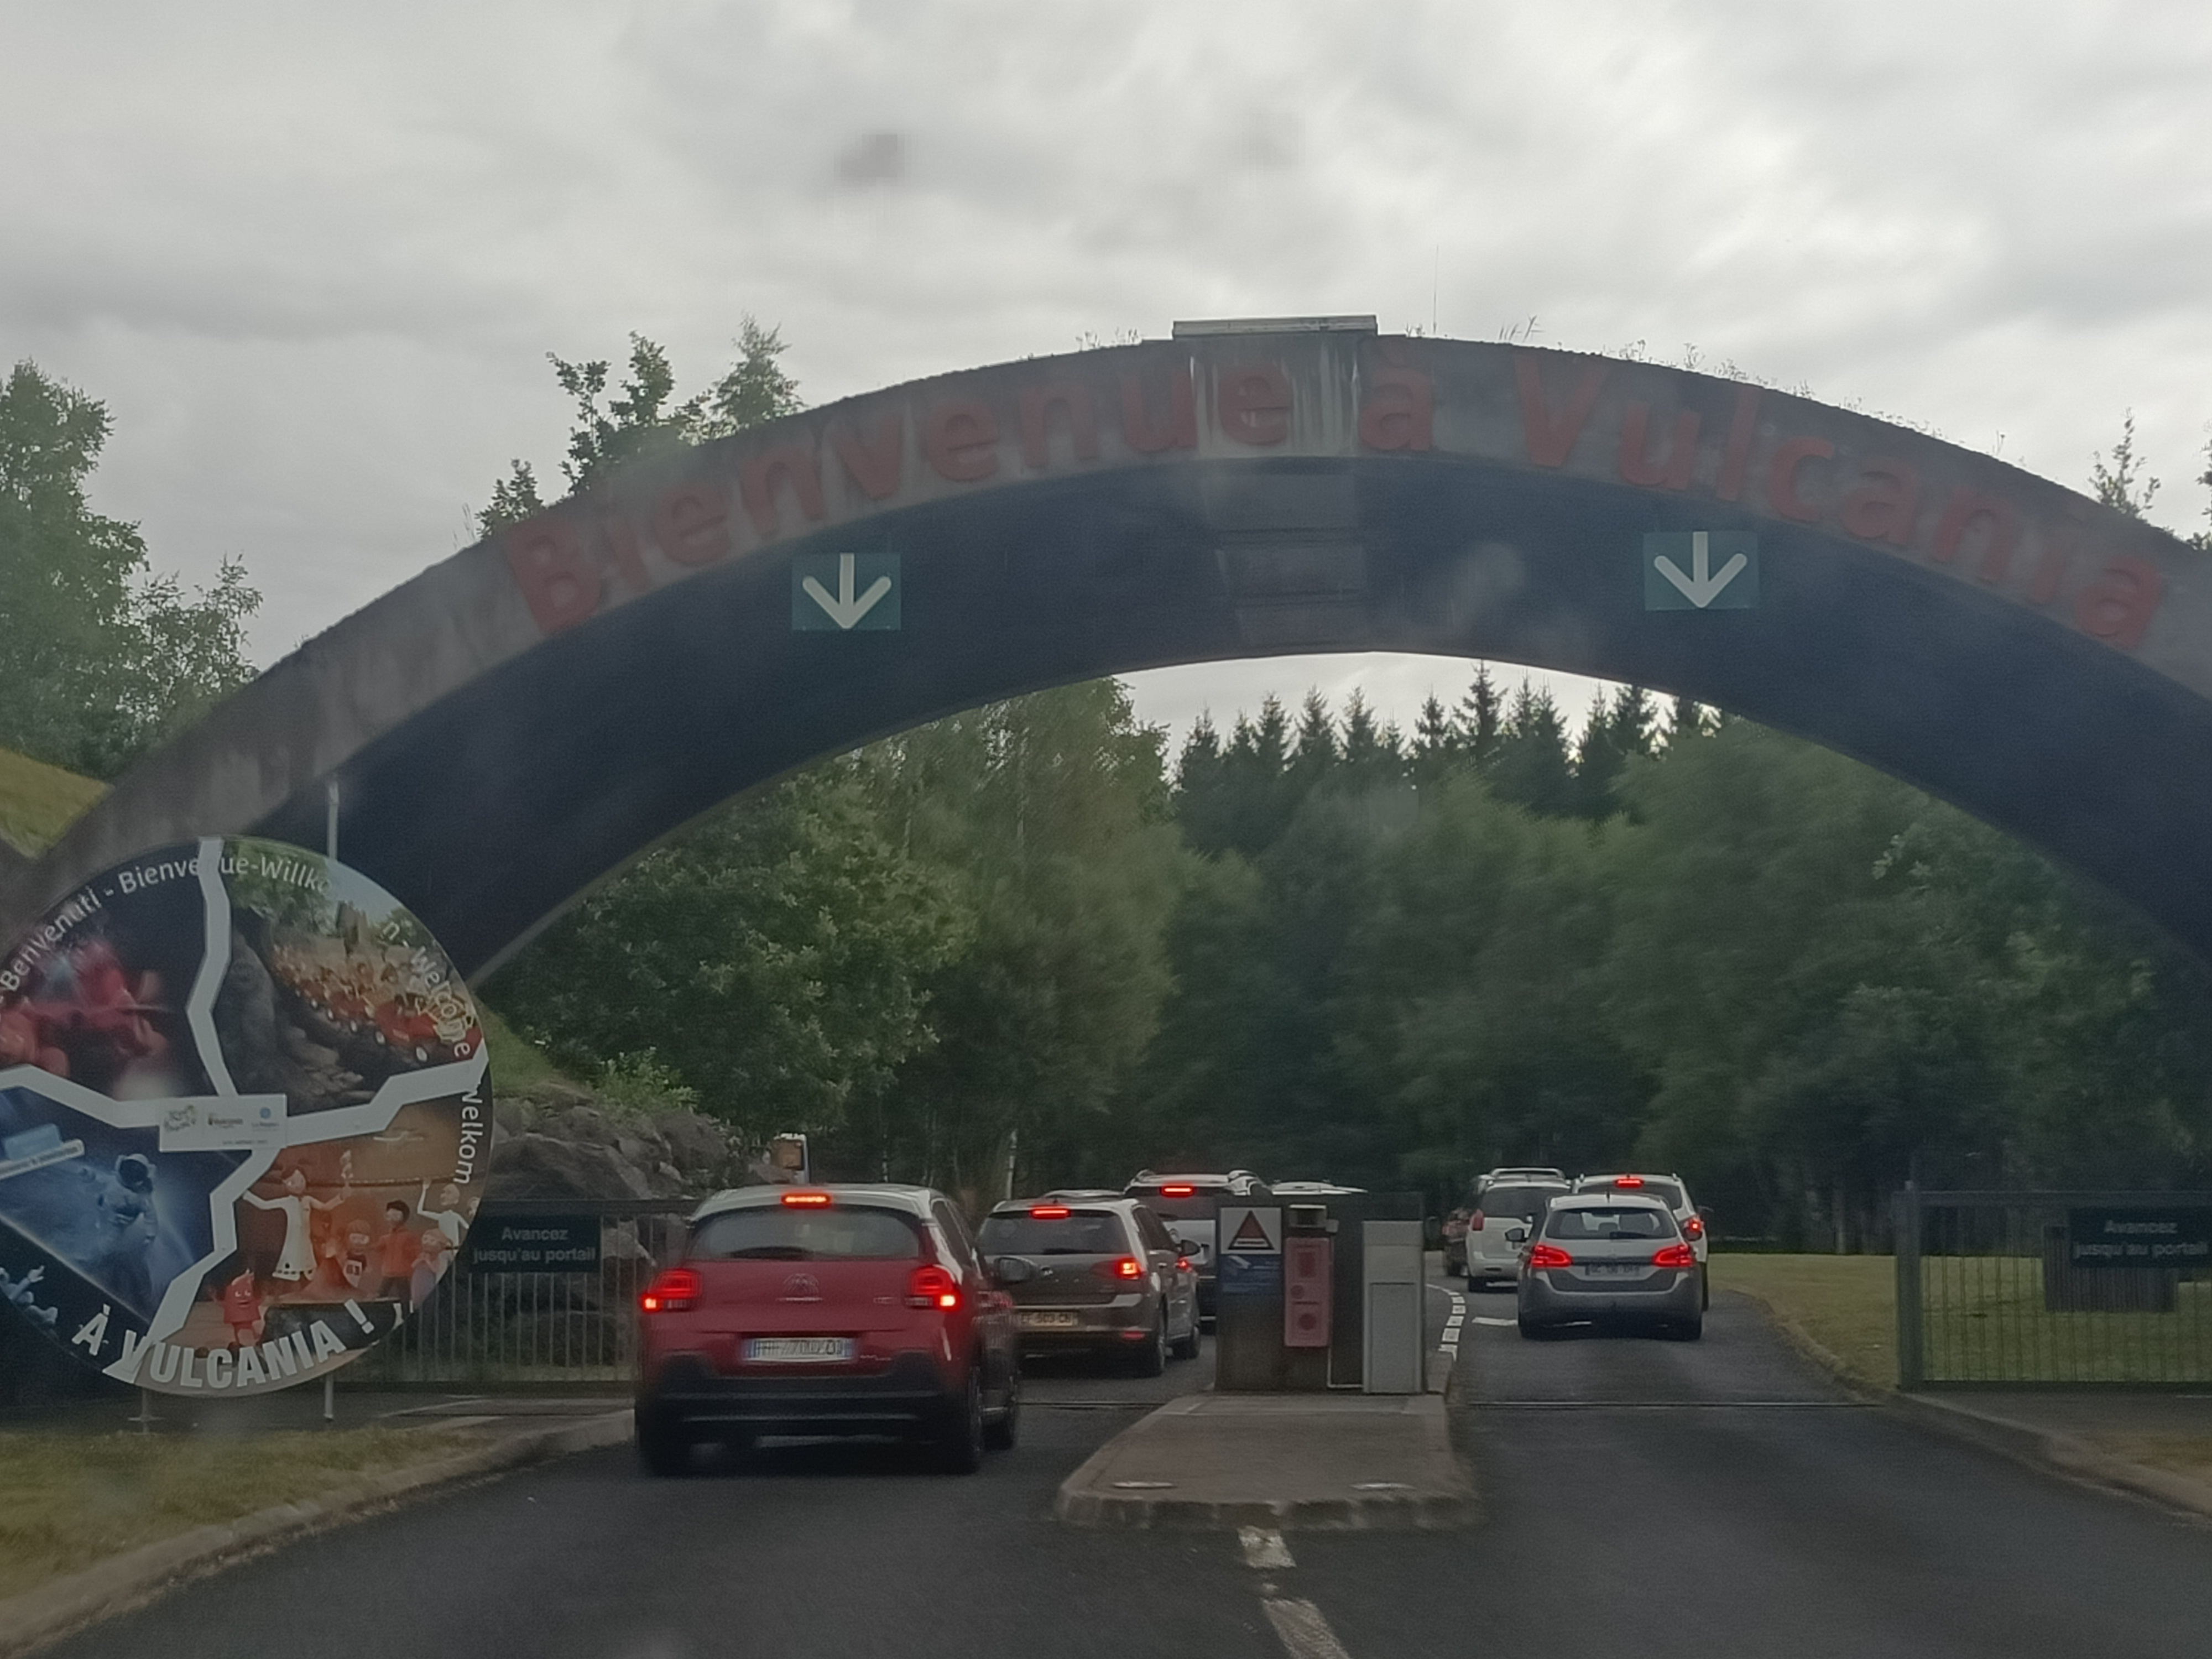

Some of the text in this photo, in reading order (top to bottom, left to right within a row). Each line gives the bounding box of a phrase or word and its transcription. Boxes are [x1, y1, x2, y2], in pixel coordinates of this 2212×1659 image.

[502, 361, 1294, 637] Bienvenue
[1512, 351, 2163, 649] Vulcania
[0, 885, 102, 992] Benvenuti
[118, 856, 249, 895] Bienveue
[501, 1226, 568, 1240] Avancez
[545, 1246, 596, 1264] portail
[119, 1319, 347, 1389] VULCANIA
